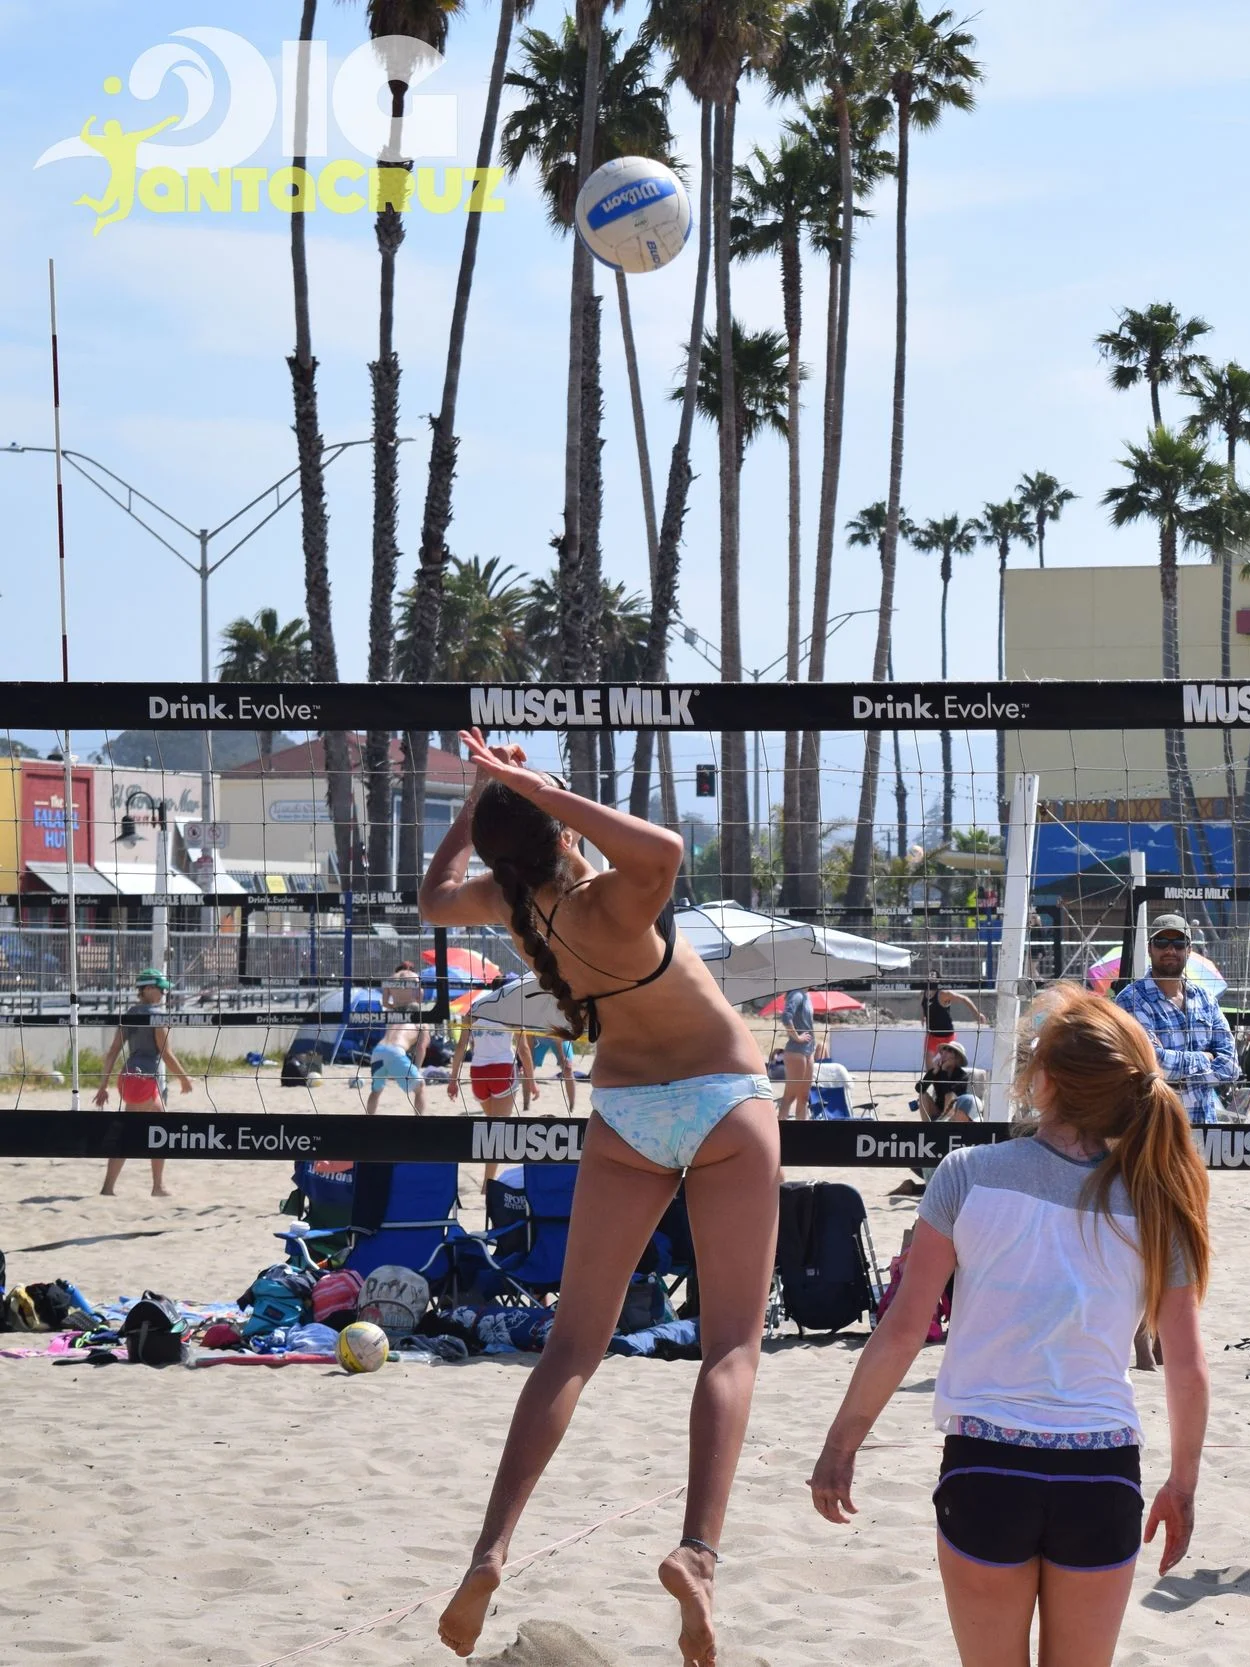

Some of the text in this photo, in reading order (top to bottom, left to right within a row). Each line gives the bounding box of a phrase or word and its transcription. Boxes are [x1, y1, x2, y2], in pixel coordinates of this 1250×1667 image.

[601, 182, 660, 213] Wilson
[149, 694, 234, 720] Drink.
[471, 686, 601, 726] MUSCLE
[853, 694, 938, 720] Drink.
[142, 894, 204, 905] MUSCLE MILK
[378, 892, 402, 903] MILK
[1165, 887, 1230, 899] MUSCLE MILK
[150, 1015, 213, 1025] MUSCLE MILK
[350, 1013, 412, 1024] MUSCLE MILK
[149, 1125, 233, 1151] Drink.
[472, 1121, 584, 1161] MUSCL
[856, 1133, 943, 1159] Drink.
